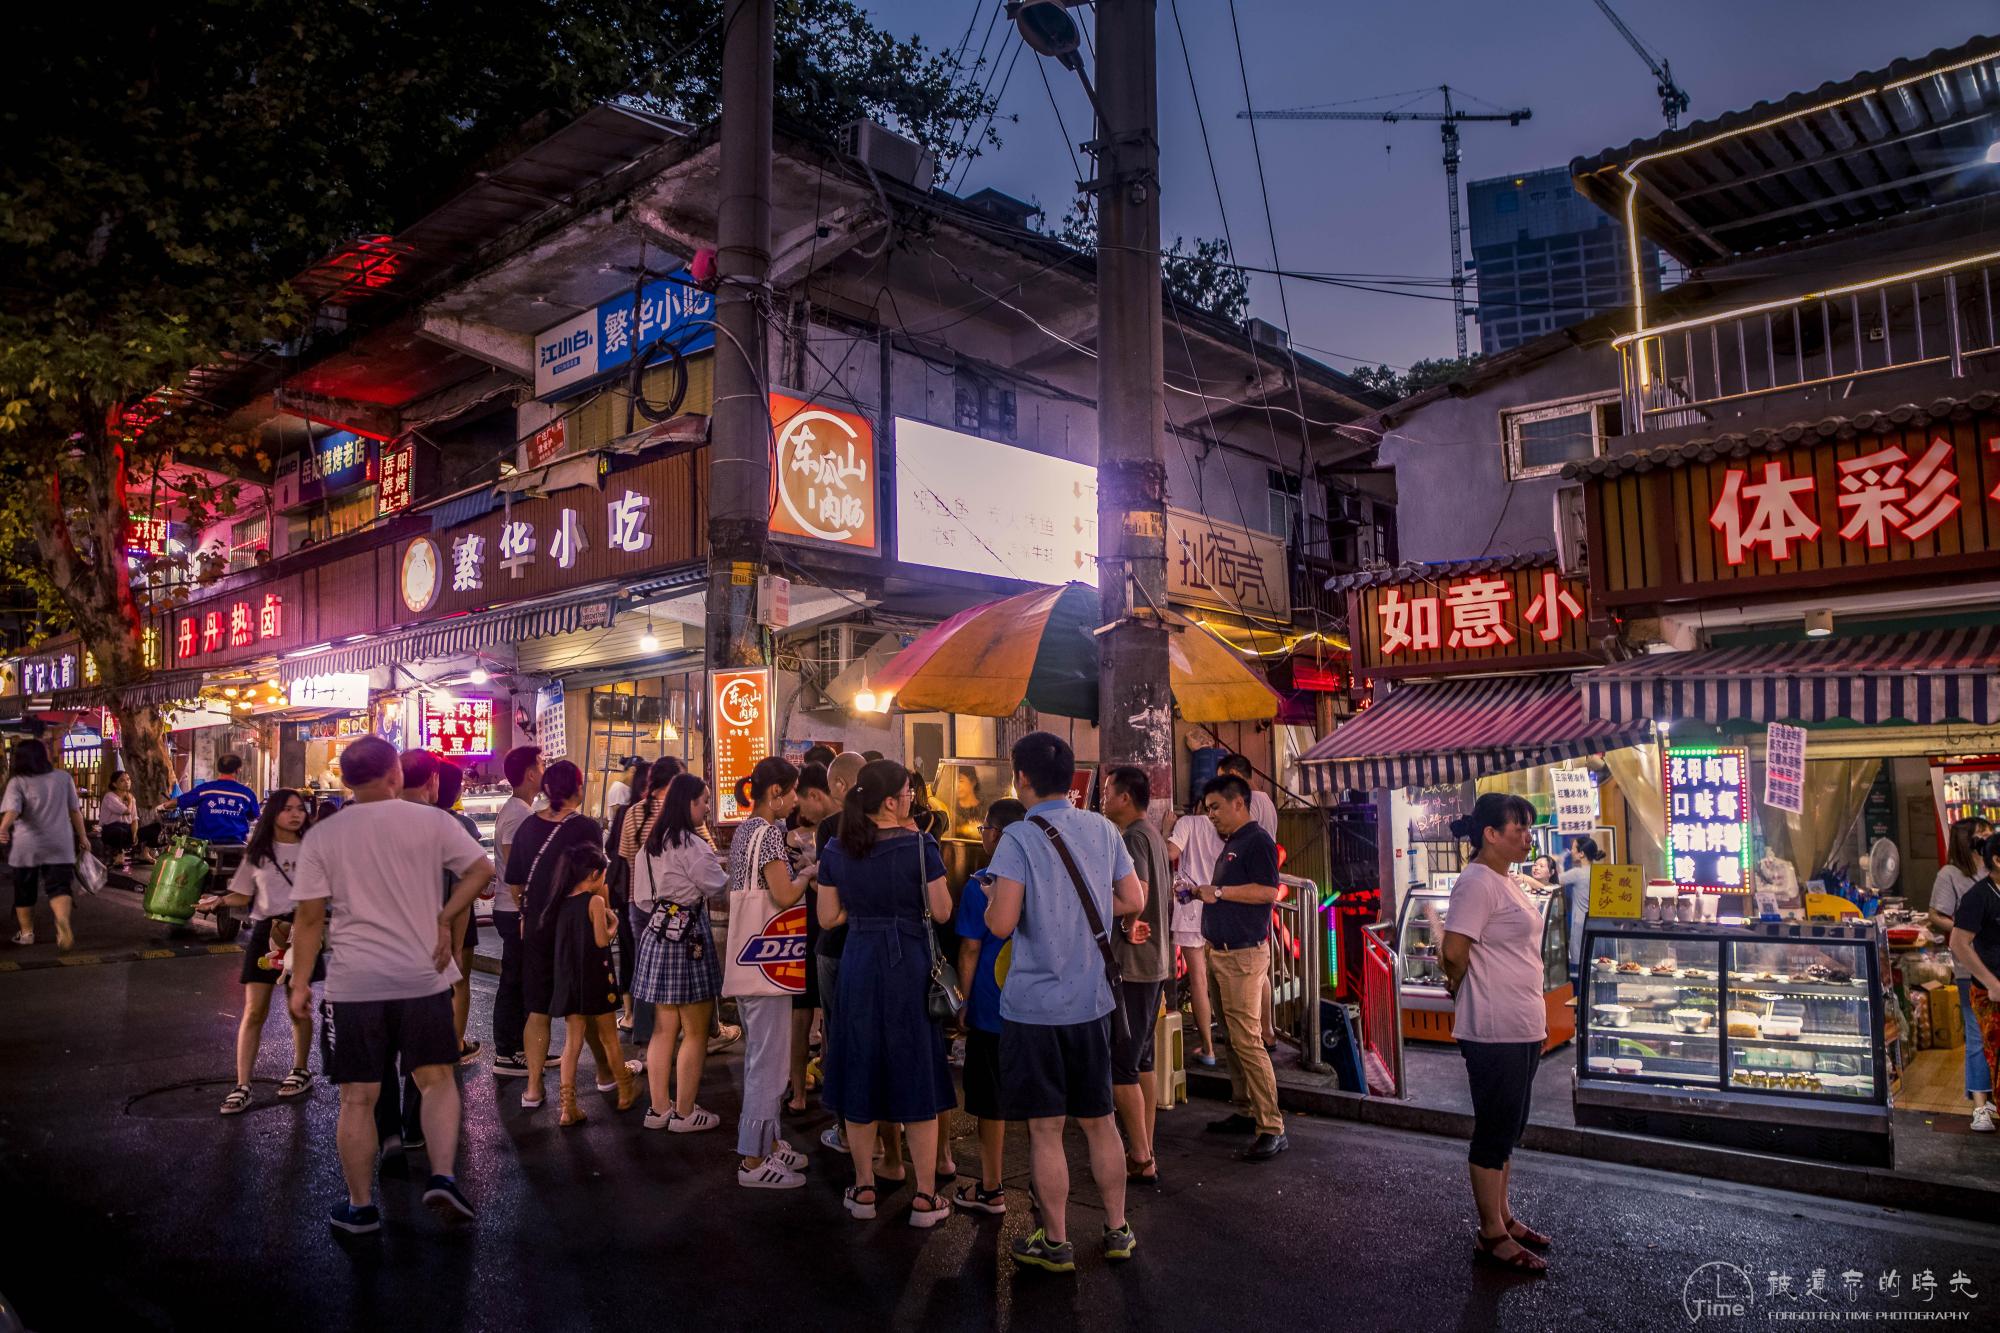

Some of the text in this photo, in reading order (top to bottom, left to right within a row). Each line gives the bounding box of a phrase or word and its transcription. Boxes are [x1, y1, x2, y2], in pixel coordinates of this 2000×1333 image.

[604, 284, 710, 354] 繁华小吃
[541, 330, 592, 367] 江小白
[303, 437, 365, 483] 岳阳烧烤老店
[383, 452, 408, 478] 岳阳
[790, 425, 866, 489] 东瓜山
[382, 472, 407, 495] 烧烤
[1710, 437, 2000, 565] 体彩
[820, 487, 864, 528] 肉肠
[453, 491, 652, 592] 繁华小吃
[179, 594, 281, 657] 丹丹热卤
[1378, 573, 1583, 655] 如意小
[427, 702, 488, 718] 肉饼
[427, 719, 488, 735] 香蕉飞饼
[427, 737, 488, 753] 臭豆腐
[1671, 755, 1740, 786] 花甲虾尾
[1674, 788, 1739, 819] 口味虾
[755, 938, 806, 958] Dic
